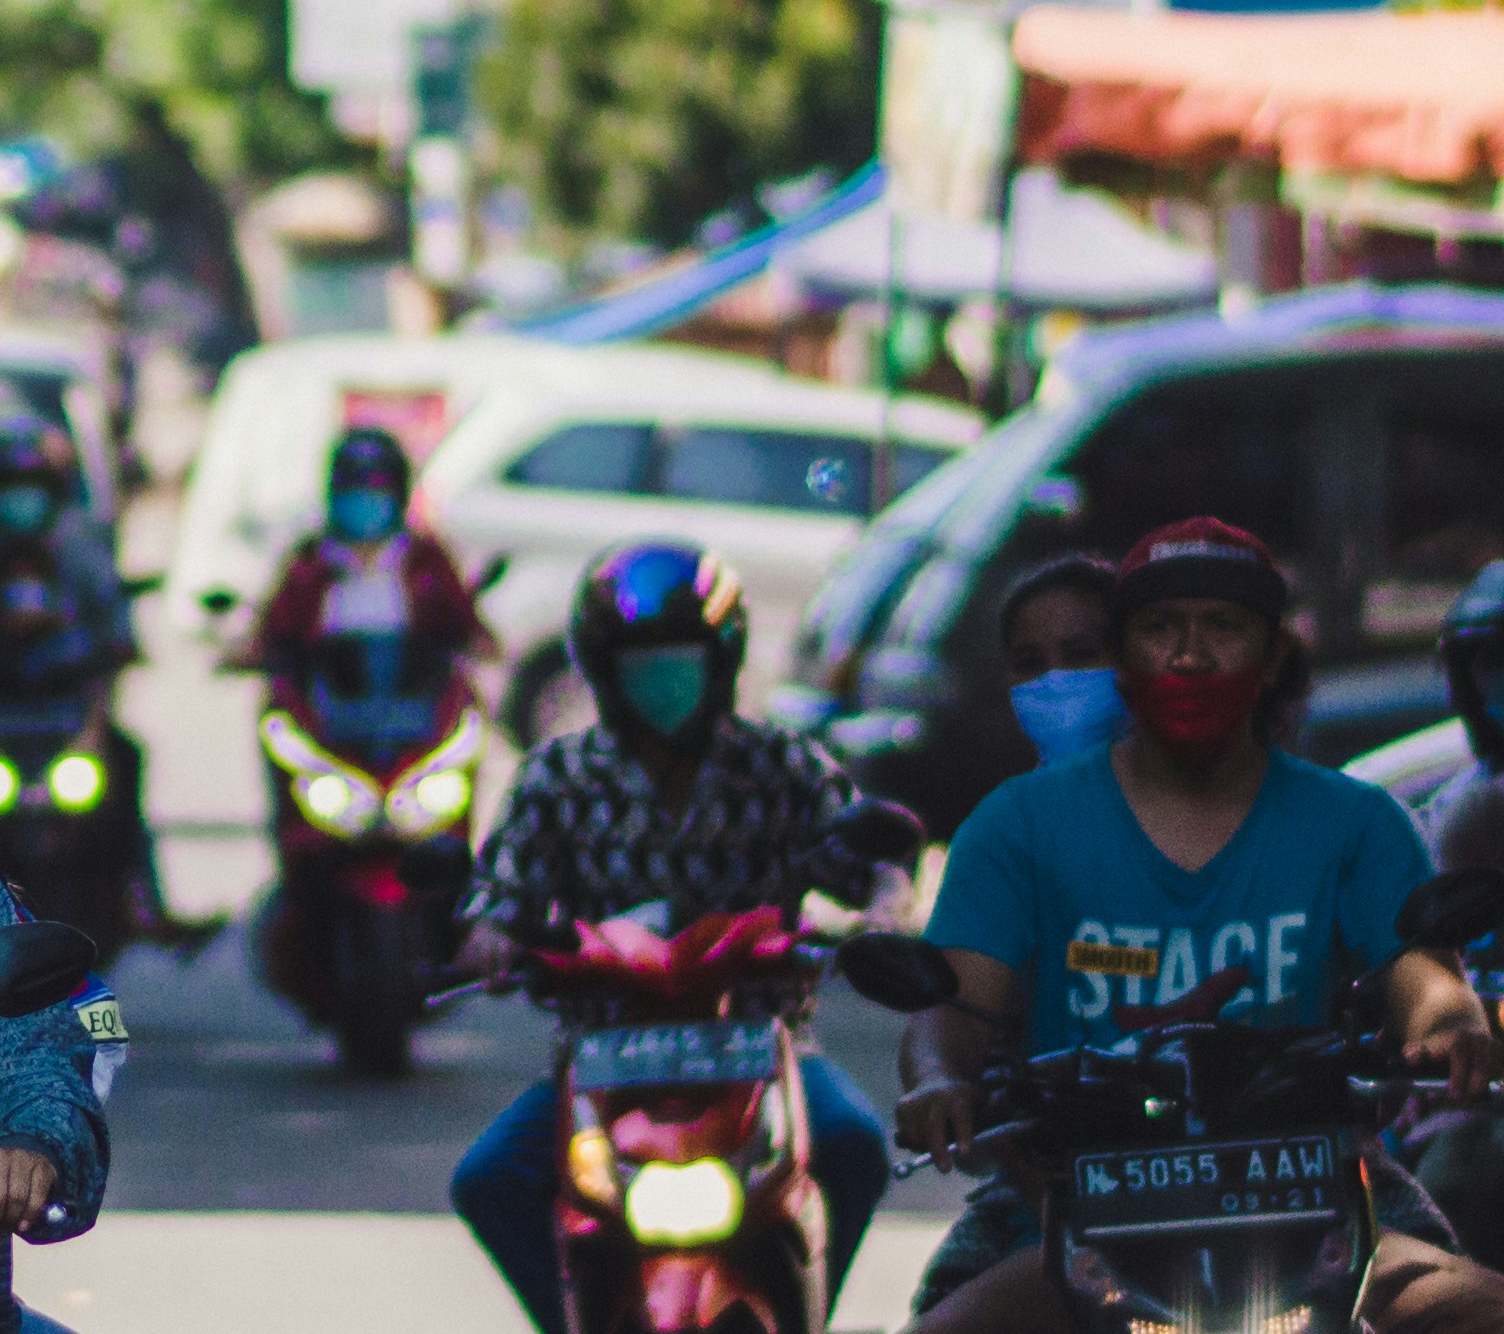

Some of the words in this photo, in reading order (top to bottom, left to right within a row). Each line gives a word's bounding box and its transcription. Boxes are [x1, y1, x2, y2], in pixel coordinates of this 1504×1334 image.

[89, 1009, 118, 1036] EQ
[1123, 1152, 1220, 1191] 5055
[1245, 1144, 1326, 1181] AAW
